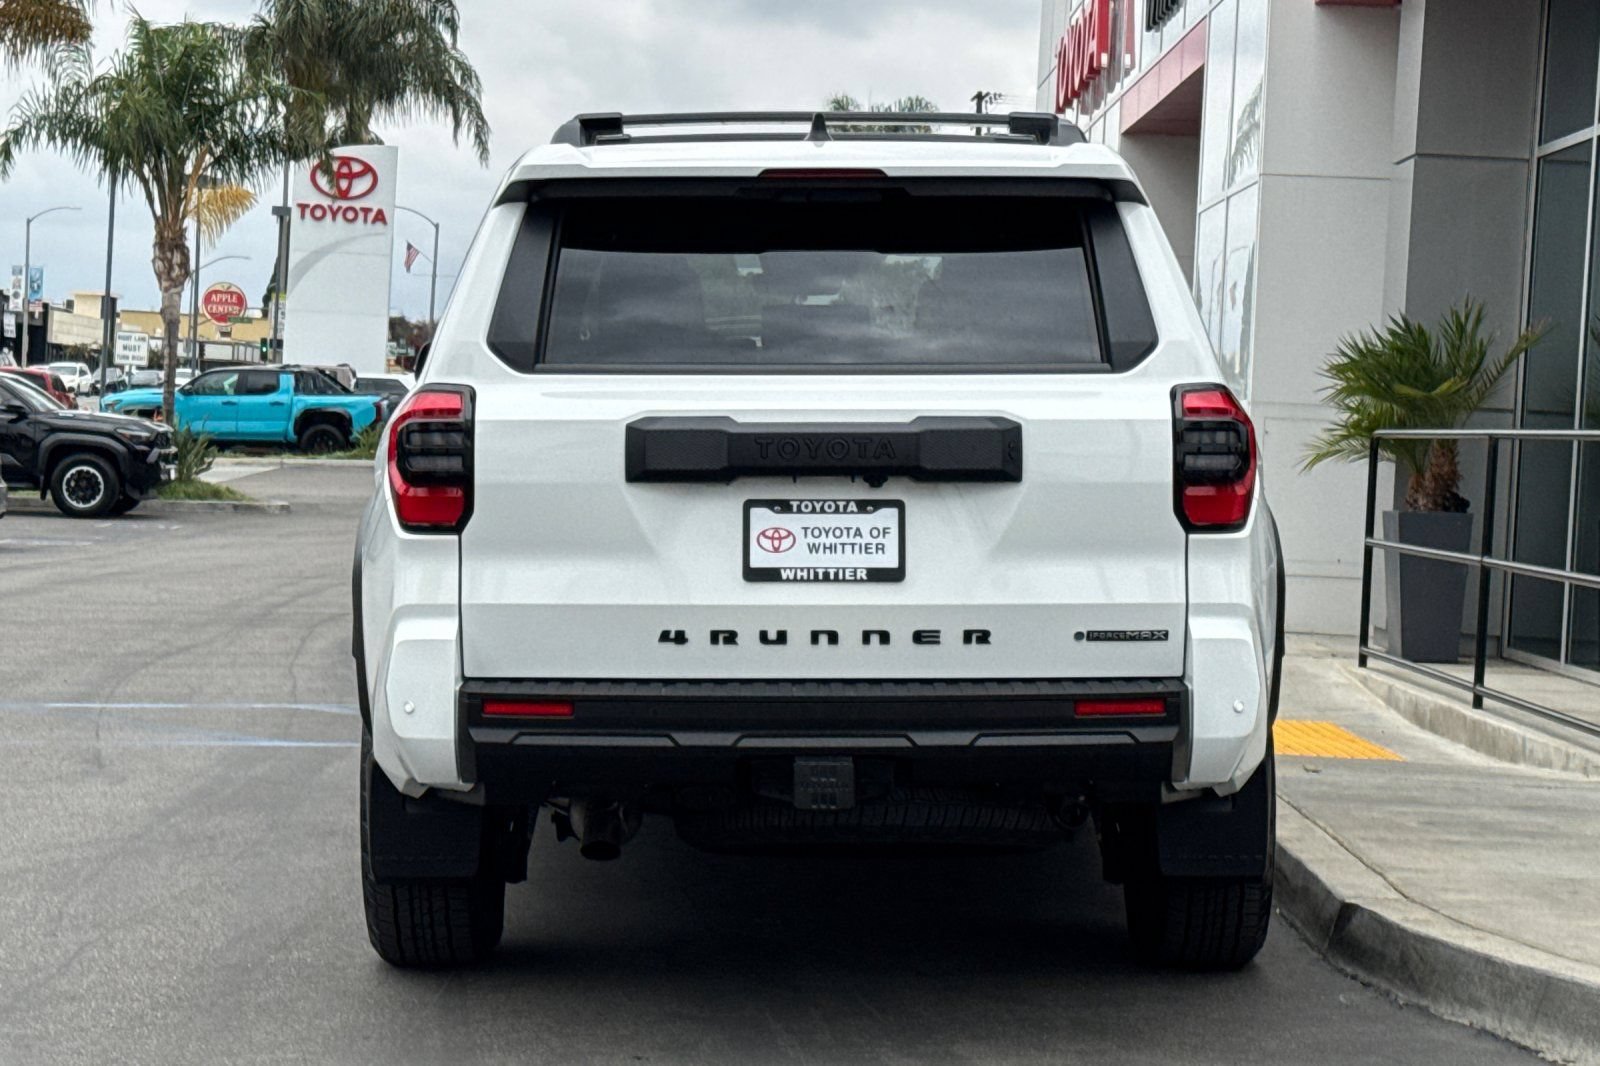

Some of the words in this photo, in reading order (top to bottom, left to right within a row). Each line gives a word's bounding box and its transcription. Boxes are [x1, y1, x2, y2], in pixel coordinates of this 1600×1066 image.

[296, 203, 388, 226] TOYOTA
[210, 293, 238, 303] APPLE
[207, 304, 241, 315] CENTER
[122, 343, 141, 352] MUST
[754, 437, 896, 461] TOYOTA
[790, 501, 858, 513] TOYOTA
[801, 526, 863, 539] TOYOTA
[869, 526, 892, 539] OF
[807, 542, 886, 555] WHITTIER
[780, 568, 868, 581] WHITTIER
